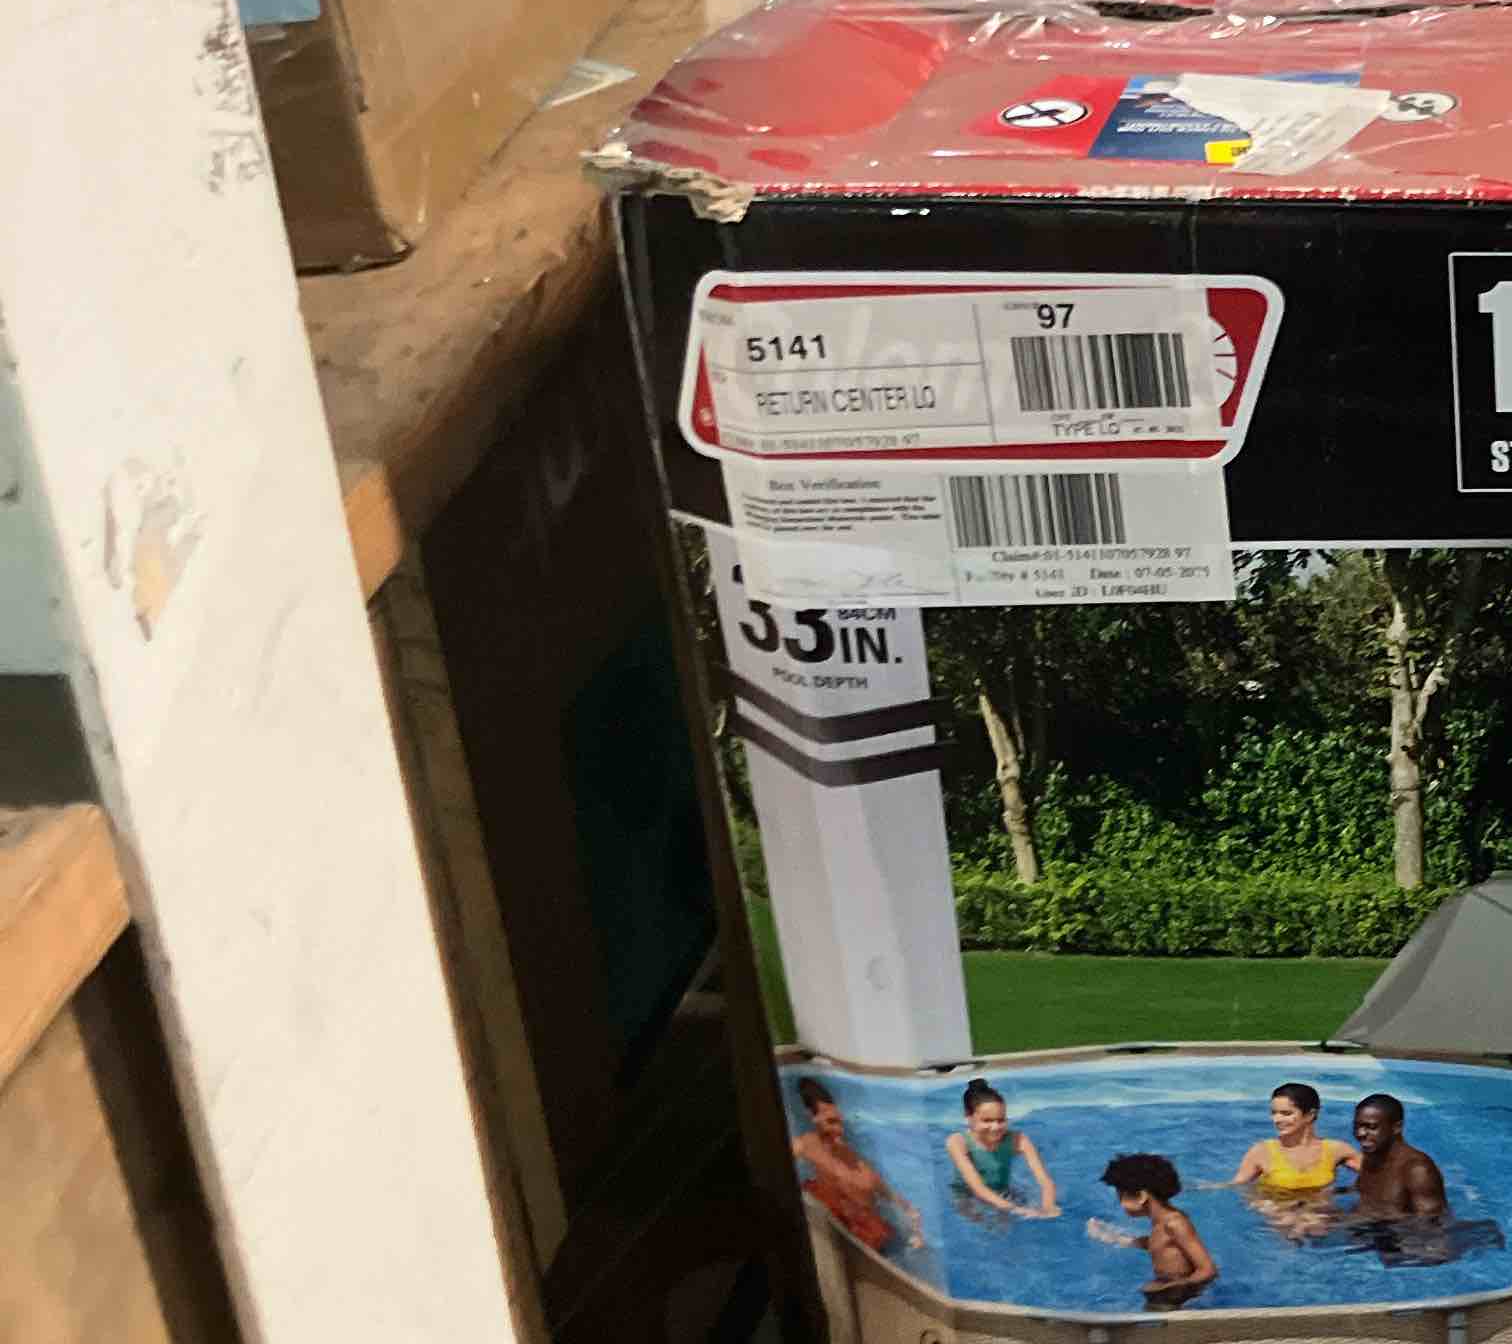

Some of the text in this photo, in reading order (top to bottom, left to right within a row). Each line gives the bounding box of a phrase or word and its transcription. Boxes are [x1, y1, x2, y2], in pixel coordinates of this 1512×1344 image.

[1037, 303, 1075, 329] 97
[745, 334, 827, 363] 5141
[755, 388, 829, 416] RETURN
[831, 385, 907, 413] CENTER
[1052, 422, 1094, 437] TYPE
[839, 626, 903, 665] IN.
[812, 675, 869, 689] DEPTH
